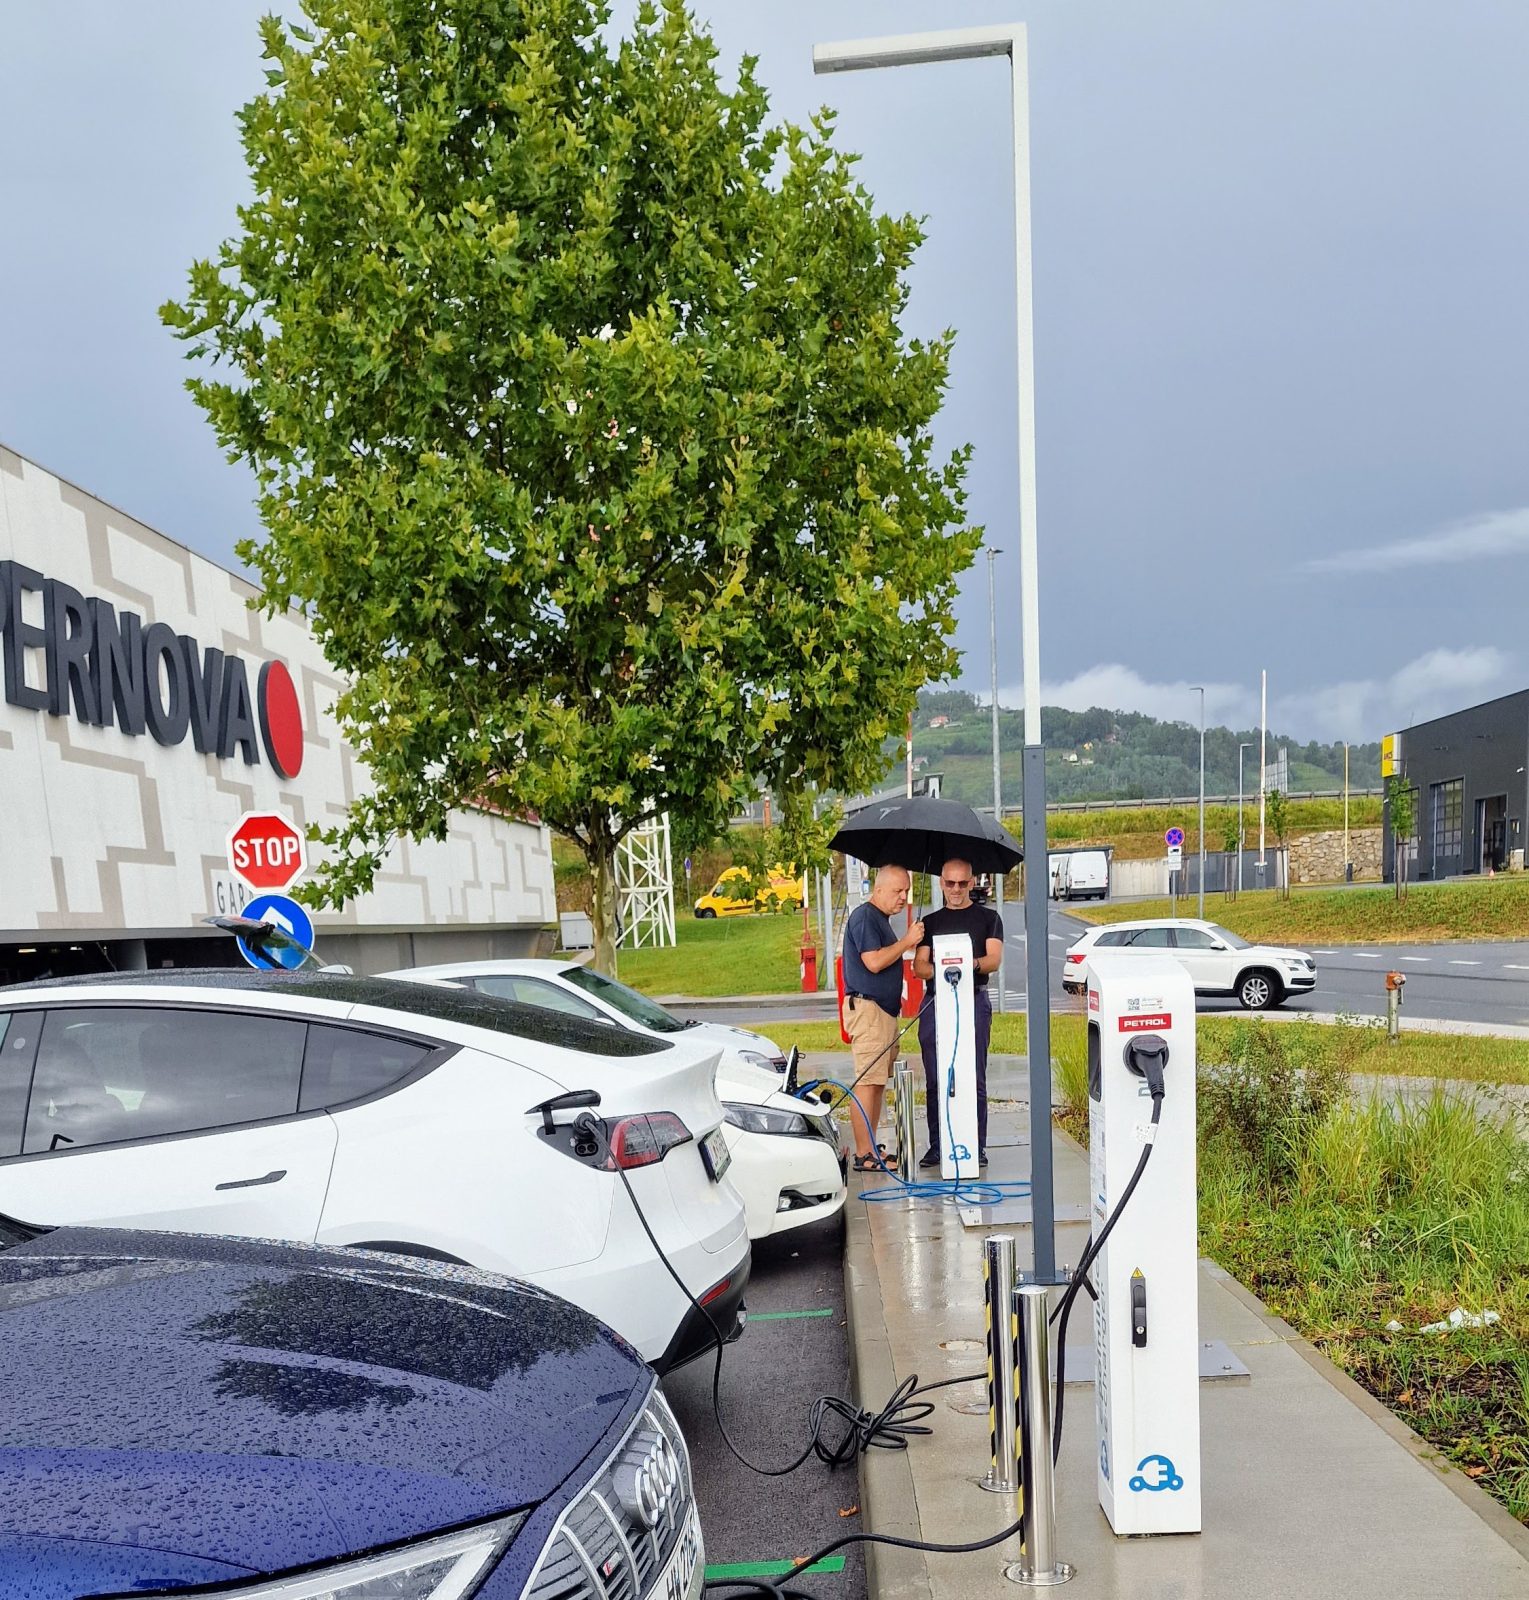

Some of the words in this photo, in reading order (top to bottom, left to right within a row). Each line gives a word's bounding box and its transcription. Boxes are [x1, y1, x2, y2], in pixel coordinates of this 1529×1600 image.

[0, 560, 260, 765] ERNOVA
[234, 836, 299, 868] STOP
[216, 880, 254, 914] GAR
[1123, 1018, 1167, 1028] PETROL
